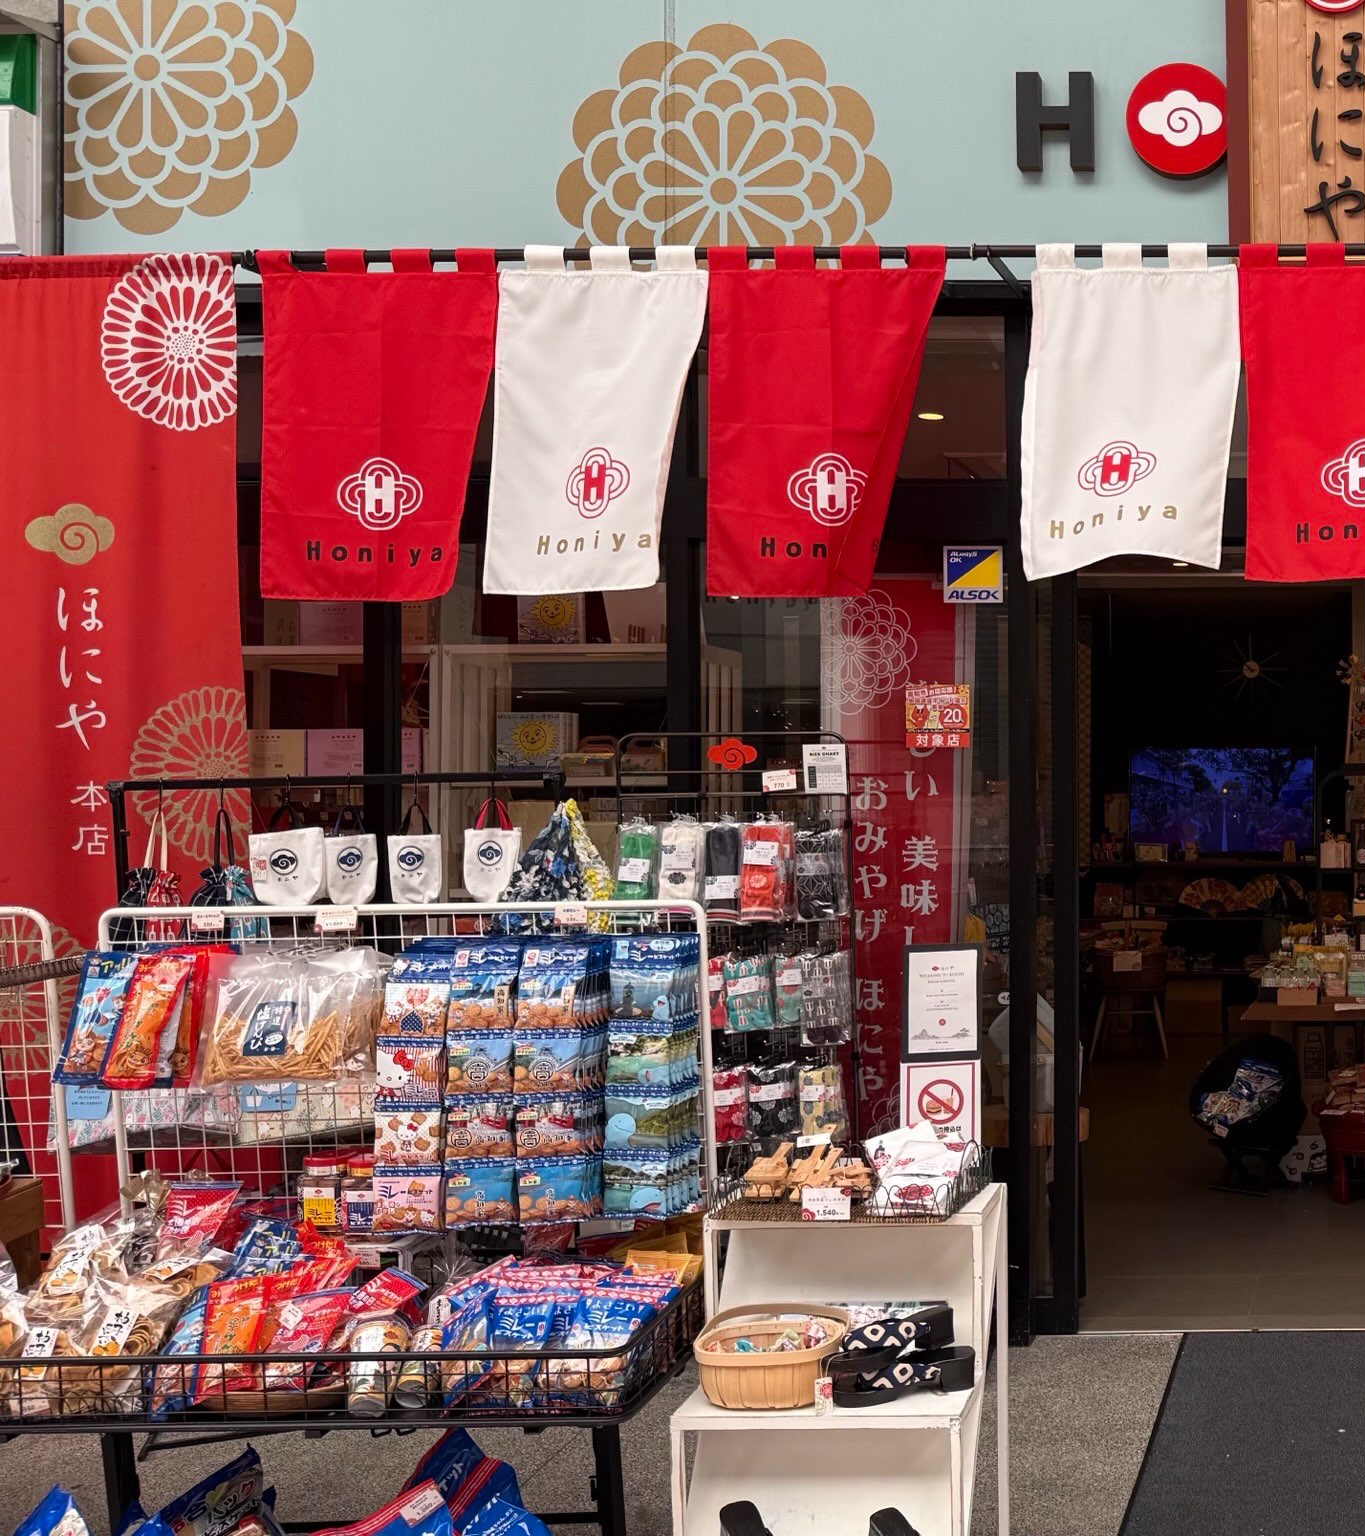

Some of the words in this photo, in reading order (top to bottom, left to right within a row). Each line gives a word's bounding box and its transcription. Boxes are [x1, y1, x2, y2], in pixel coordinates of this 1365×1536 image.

[1049, 502, 1178, 540] Honiya
[536, 531, 653, 556] Honiya
[760, 537, 828, 560] Hon
[305, 540, 443, 567] Honiya
[948, 590, 999, 600] ALSOK
[55, 586, 107, 751] ほにや
[943, 708, 961, 723] 20
[915, 734, 961, 747] 対象店
[70, 780, 109, 857] 本店
[854, 775, 889, 943] おみやげ
[504, 1307, 541, 1317] よさこい
[588, 1310, 627, 1323] ミレー
[499, 1316, 535, 1331] ミレー
[584, 1323, 624, 1332] ビスケット
[495, 1329, 534, 1339] ビスケット
